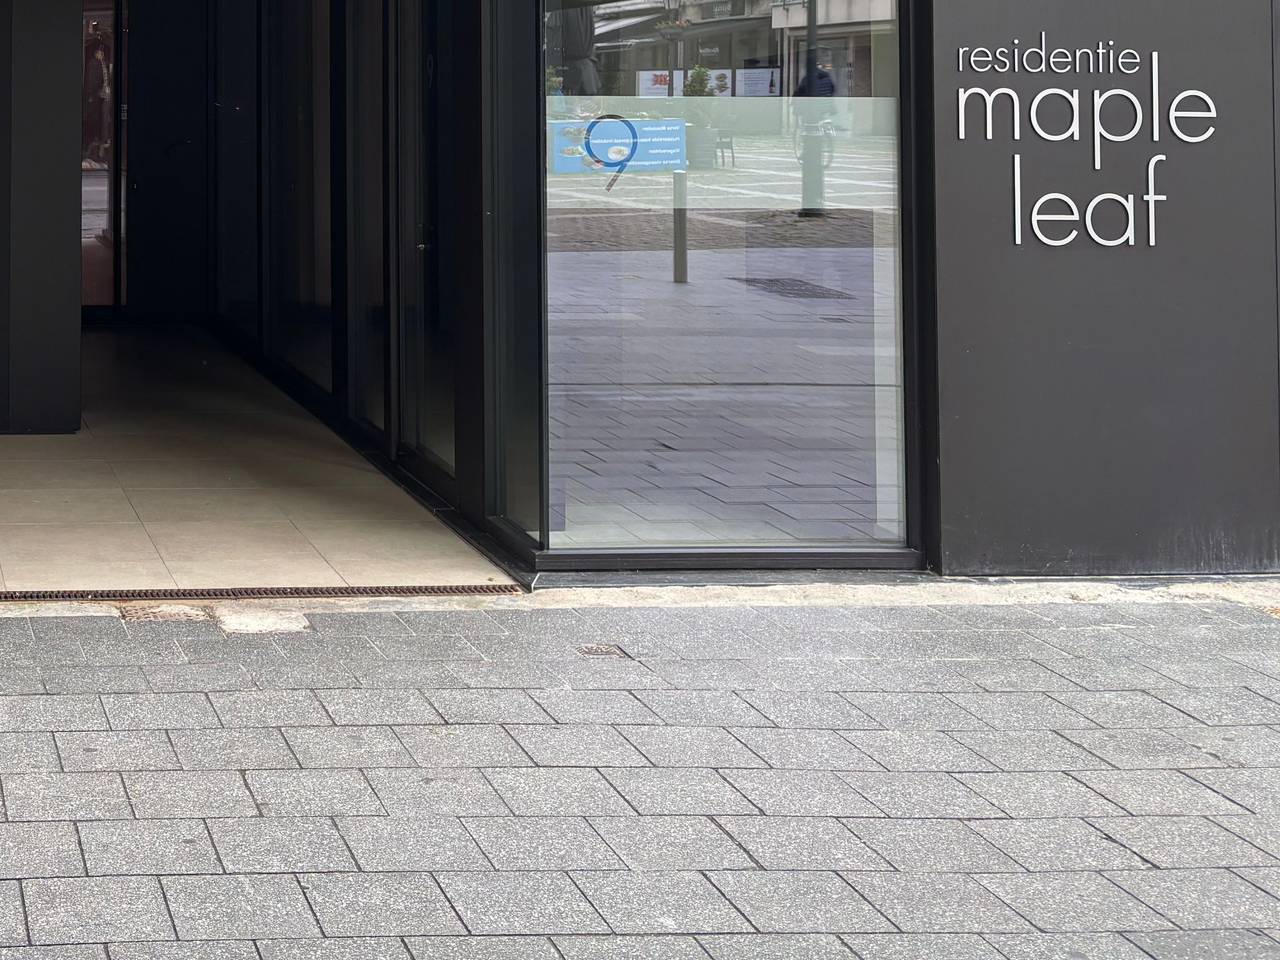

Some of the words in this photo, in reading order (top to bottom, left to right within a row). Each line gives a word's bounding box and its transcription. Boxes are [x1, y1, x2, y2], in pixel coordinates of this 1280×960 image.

[958, 31, 1141, 74] residentie
[584, 114, 639, 192] 9
[958, 51, 1217, 170] maple
[1014, 154, 1167, 246] leaf
